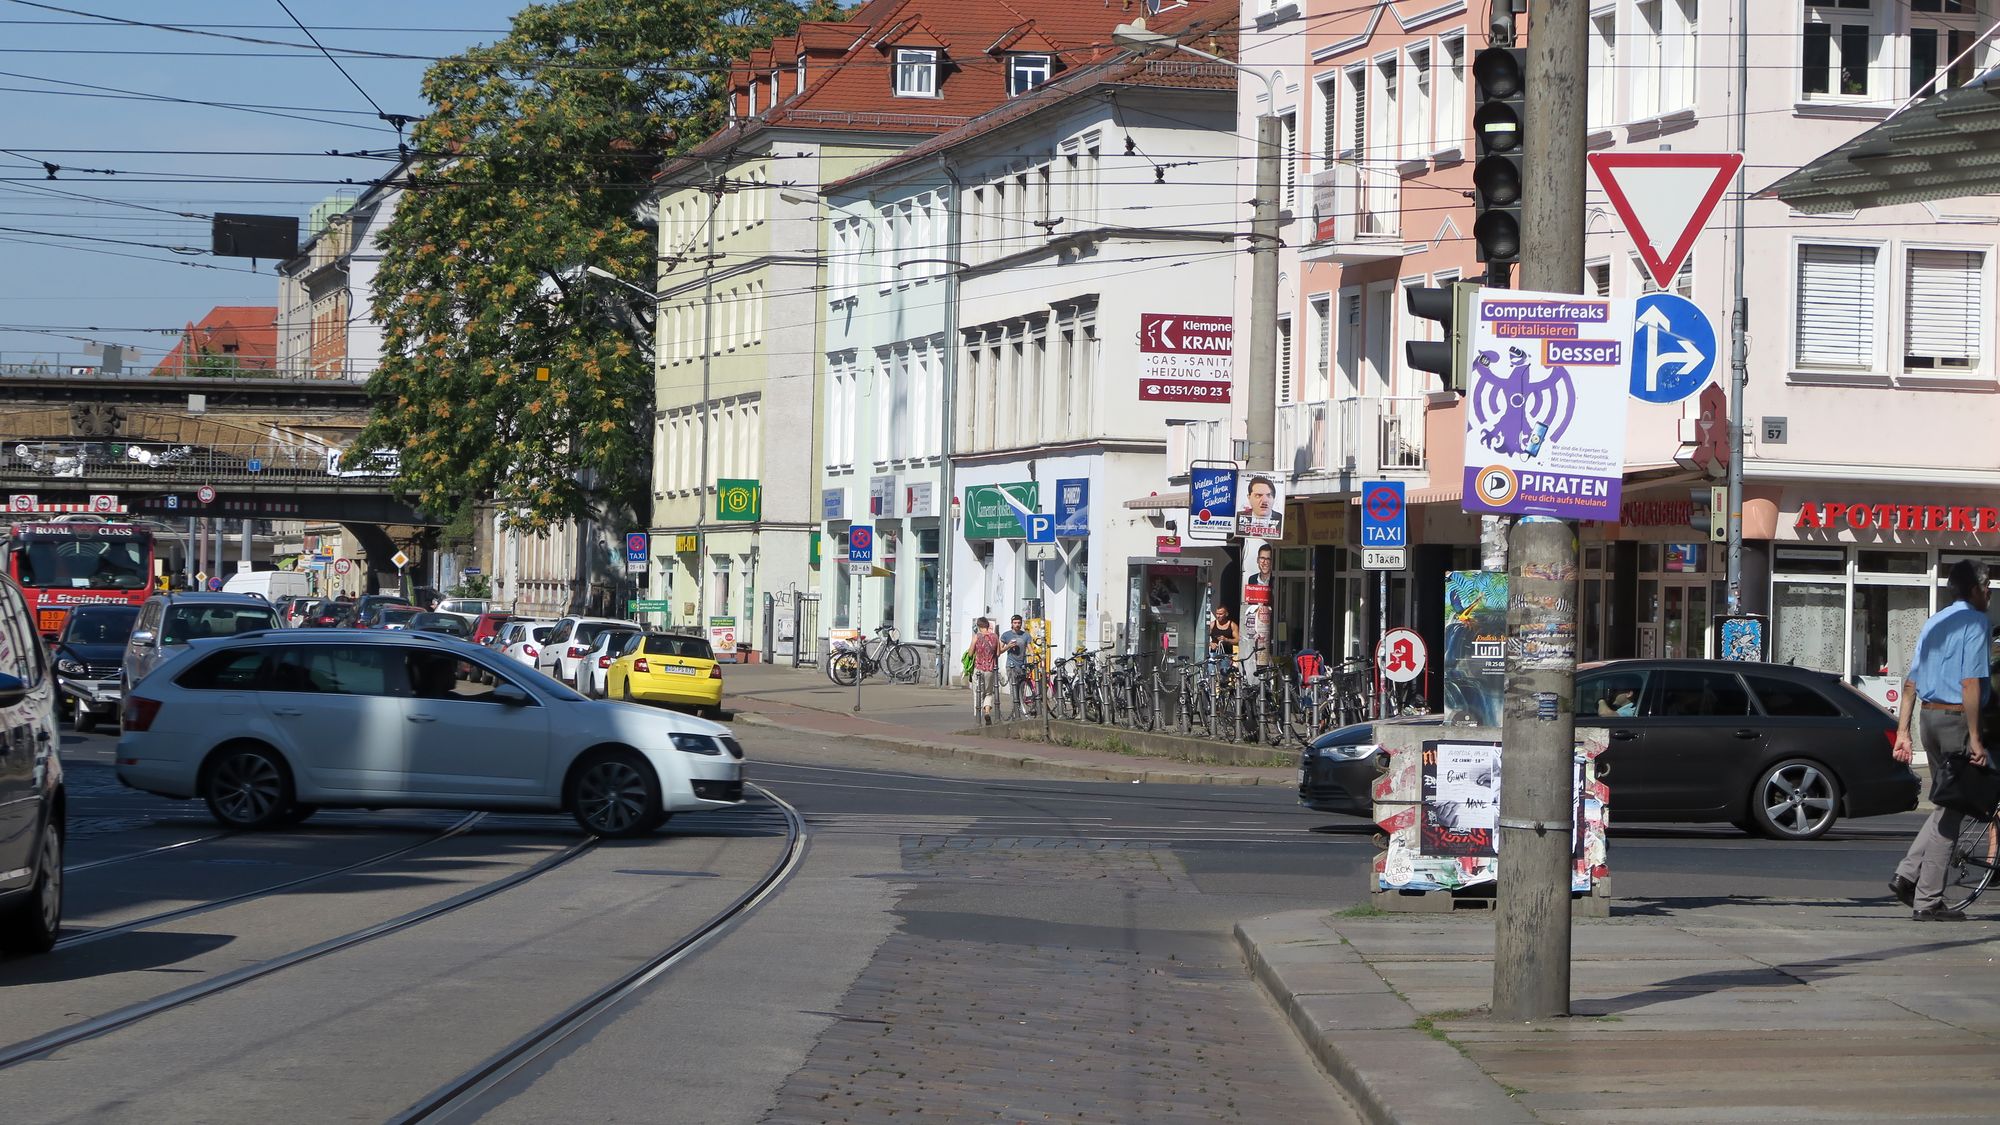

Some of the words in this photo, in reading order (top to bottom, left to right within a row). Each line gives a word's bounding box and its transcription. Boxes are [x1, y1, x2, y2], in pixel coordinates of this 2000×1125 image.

[1484, 304, 1604, 320] Computerfreaks
[1499, 324, 1576, 338] digitalisieren
[1549, 343, 1620, 362] besser!
[1152, 356, 1176, 365] GAS
[1151, 368, 1200, 378] HEIZUNG
[1163, 385, 1206, 396] 0351/80
[1210, 388, 1222, 396] 23
[1768, 430, 1781, 439] 57
[1194, 480, 1212, 490] Vielen
[1214, 472, 1231, 484] Dank
[1521, 474, 1608, 497] PIRATEN
[1202, 488, 1211, 499] für
[1213, 485, 1228, 495] Ihren
[734, 495, 742, 506] H
[1520, 492, 1537, 502] Freu
[1556, 497, 1573, 505] aufs
[1574, 498, 1607, 507] Neuland
[1794, 502, 2000, 533] APOTHEKE
[36, 527, 71, 535] ROYAL
[1033, 518, 1048, 540] P
[1366, 527, 1401, 541] TAXI
[1368, 554, 1373, 564] 3
[1375, 554, 1400, 564] Taxen
[37, 594, 52, 603] H.
